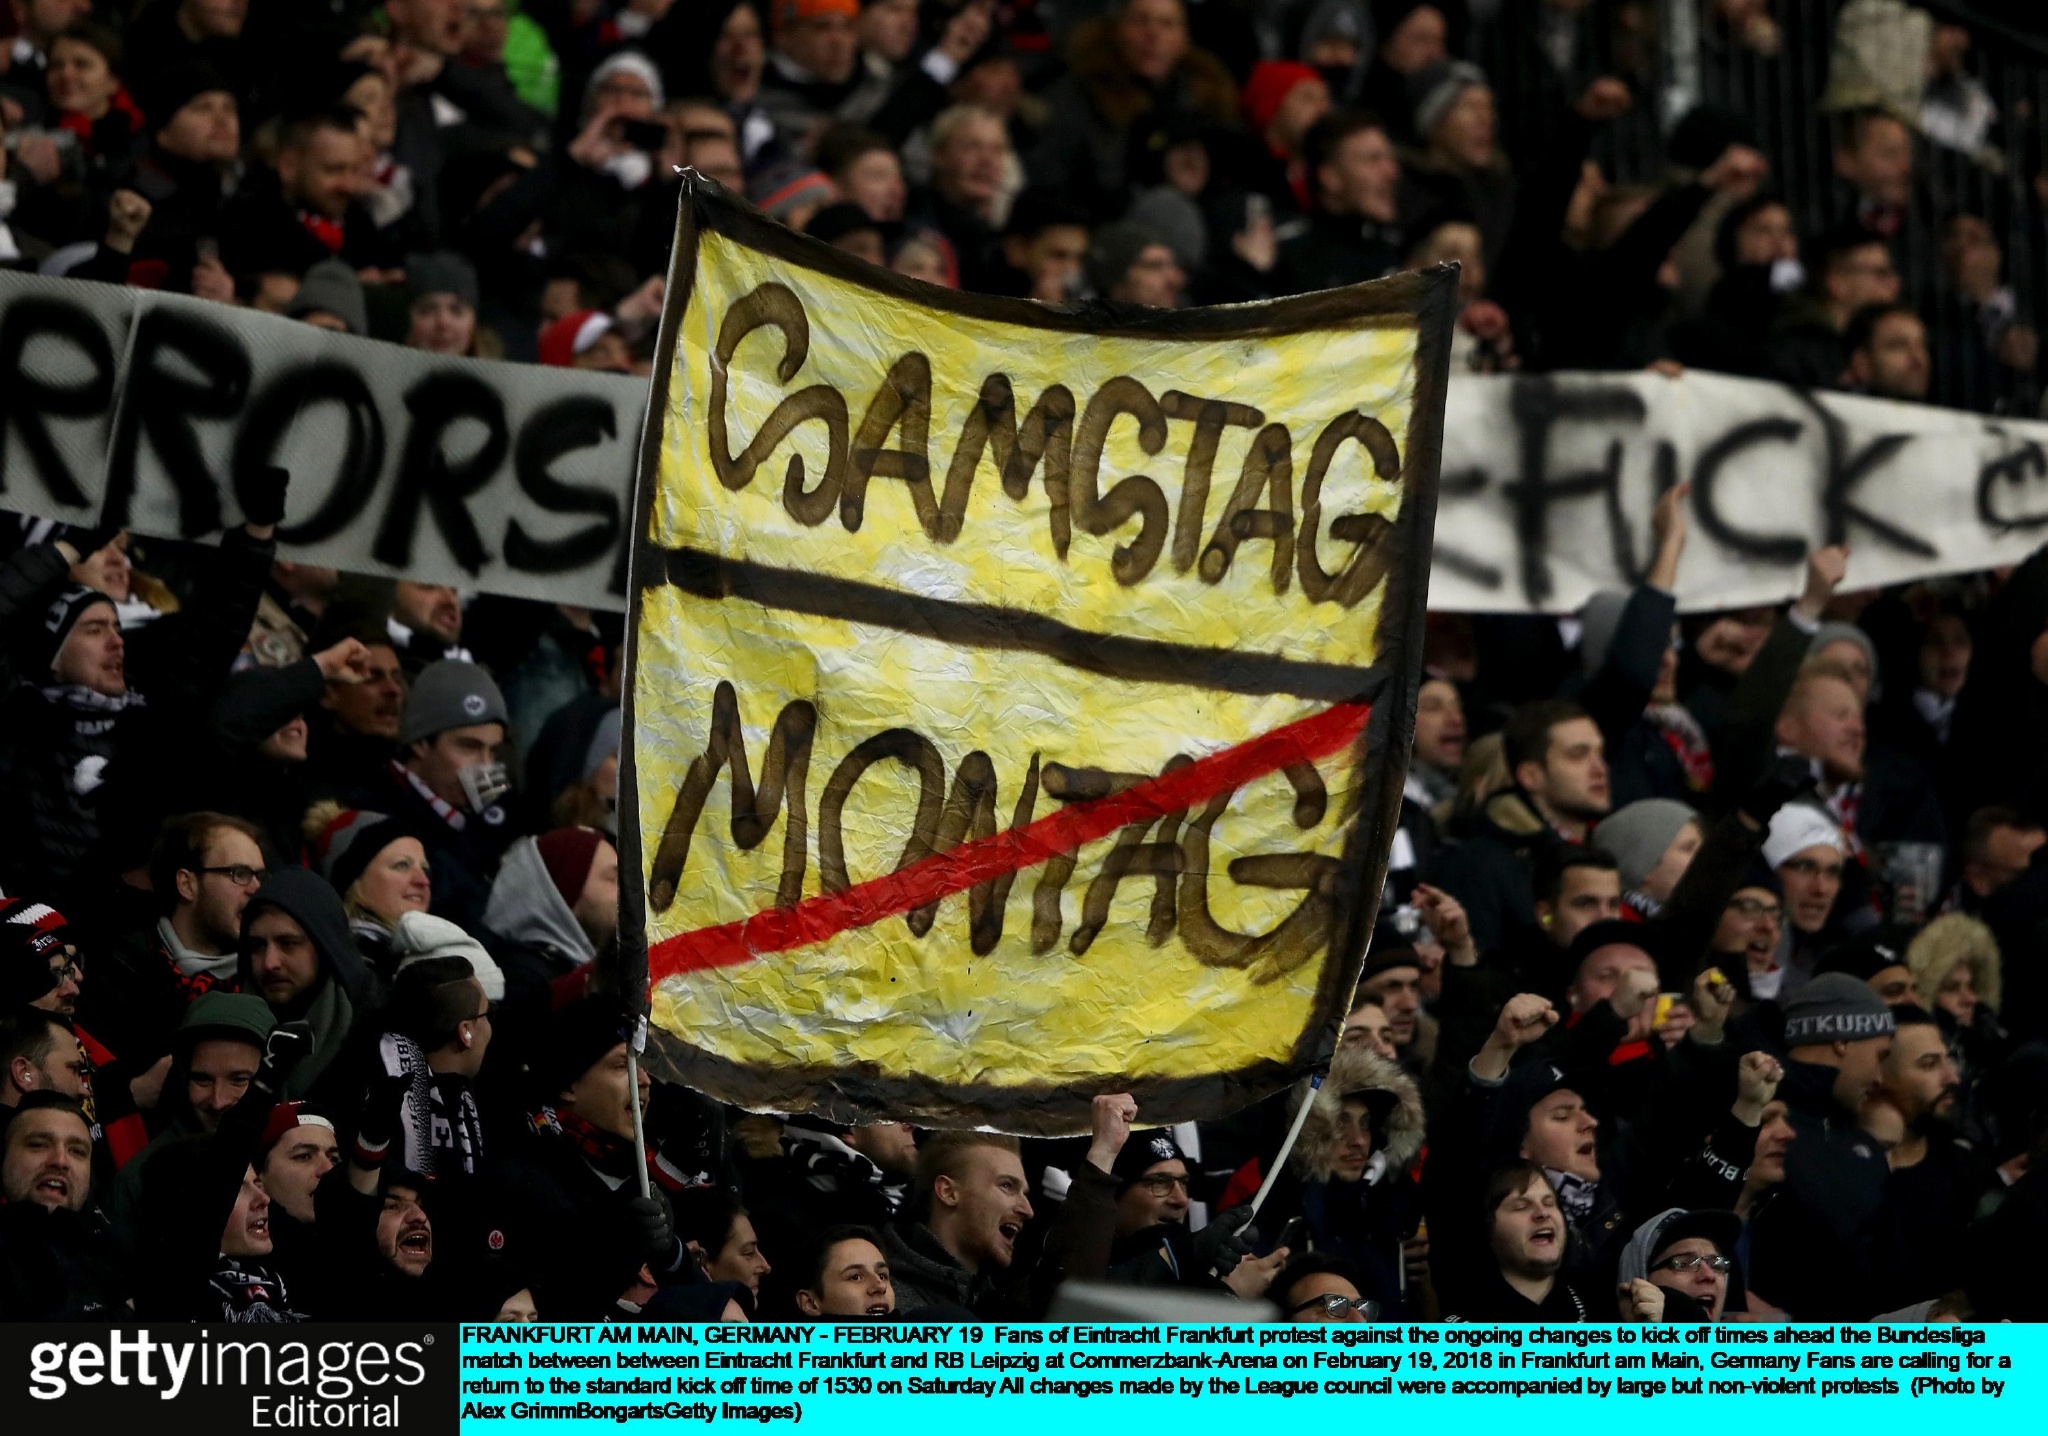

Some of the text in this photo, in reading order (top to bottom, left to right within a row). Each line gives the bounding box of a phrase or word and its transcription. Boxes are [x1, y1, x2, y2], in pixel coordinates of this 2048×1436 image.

[0, 295, 632, 600] RRORS
[708, 281, 1401, 604] SAMSTAG
[649, 680, 1347, 987] MONTAG
